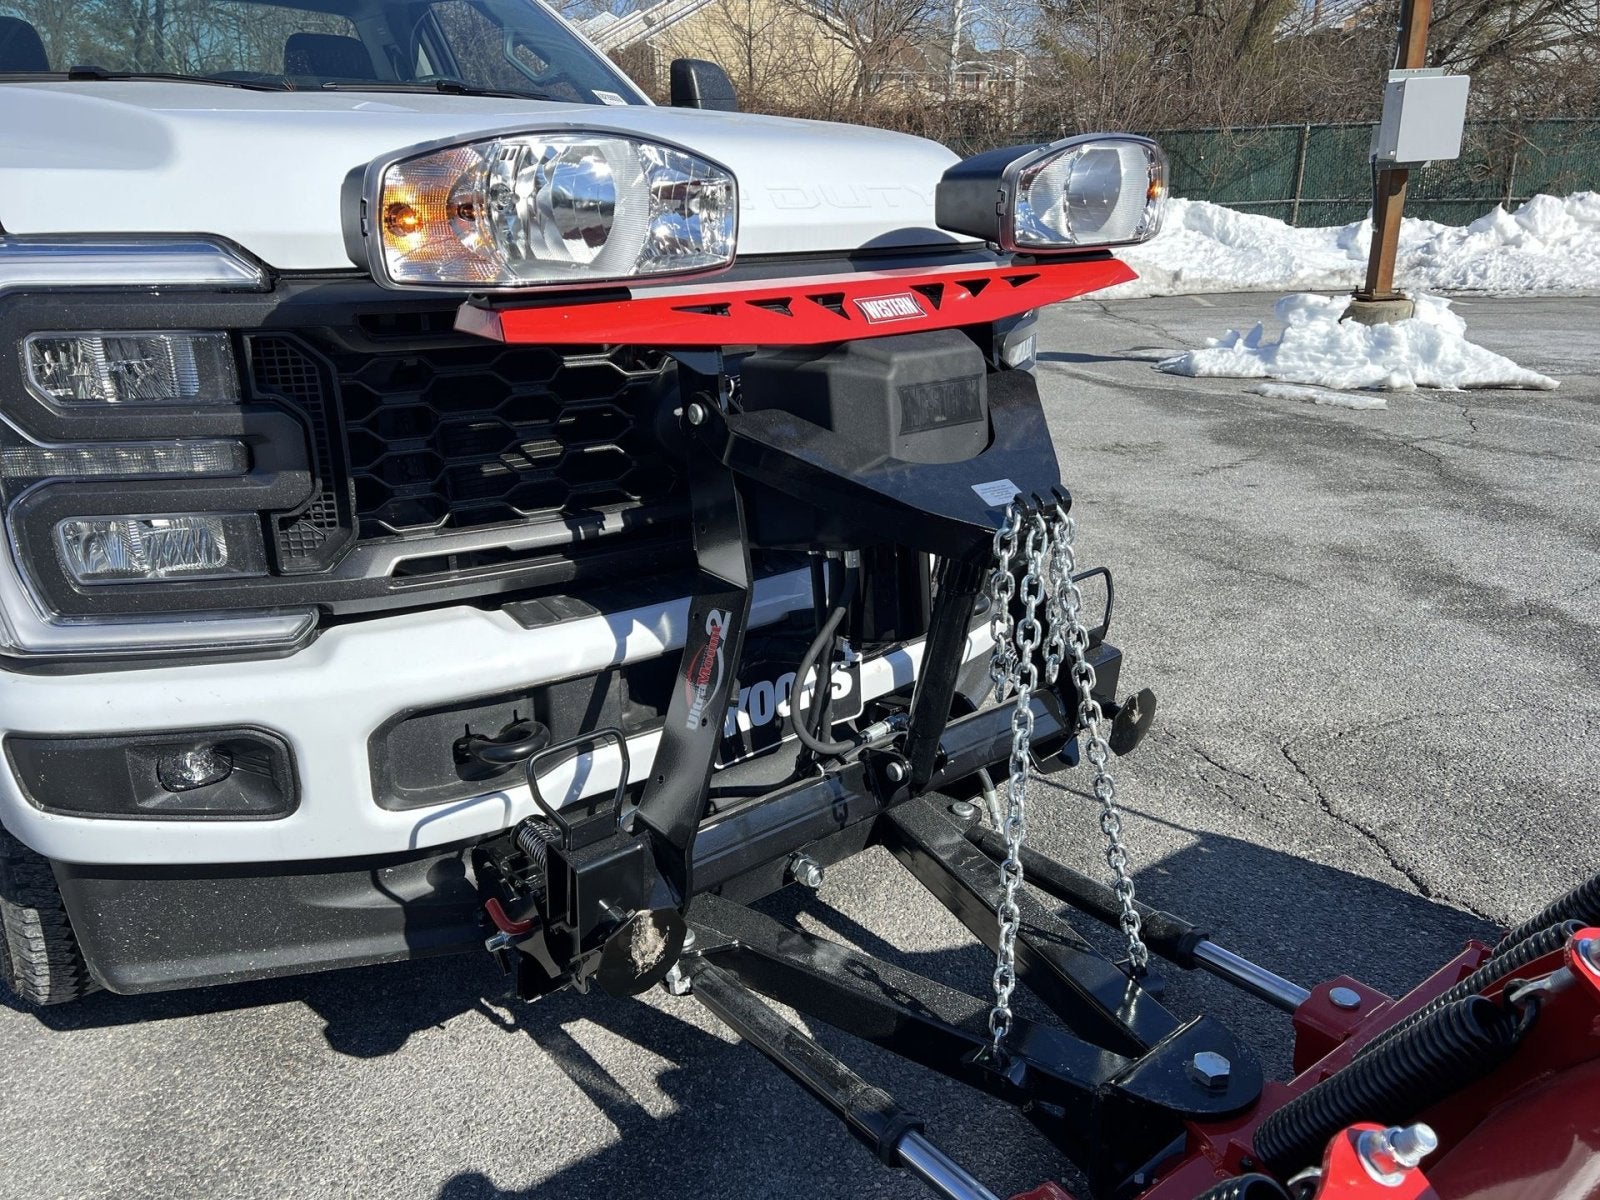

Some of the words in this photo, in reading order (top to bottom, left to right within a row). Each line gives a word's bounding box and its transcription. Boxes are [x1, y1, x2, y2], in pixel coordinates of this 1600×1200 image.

[765, 184, 933, 210] DUTY
[861, 297, 919, 319] WESTERN
[706, 609, 732, 641] 2
